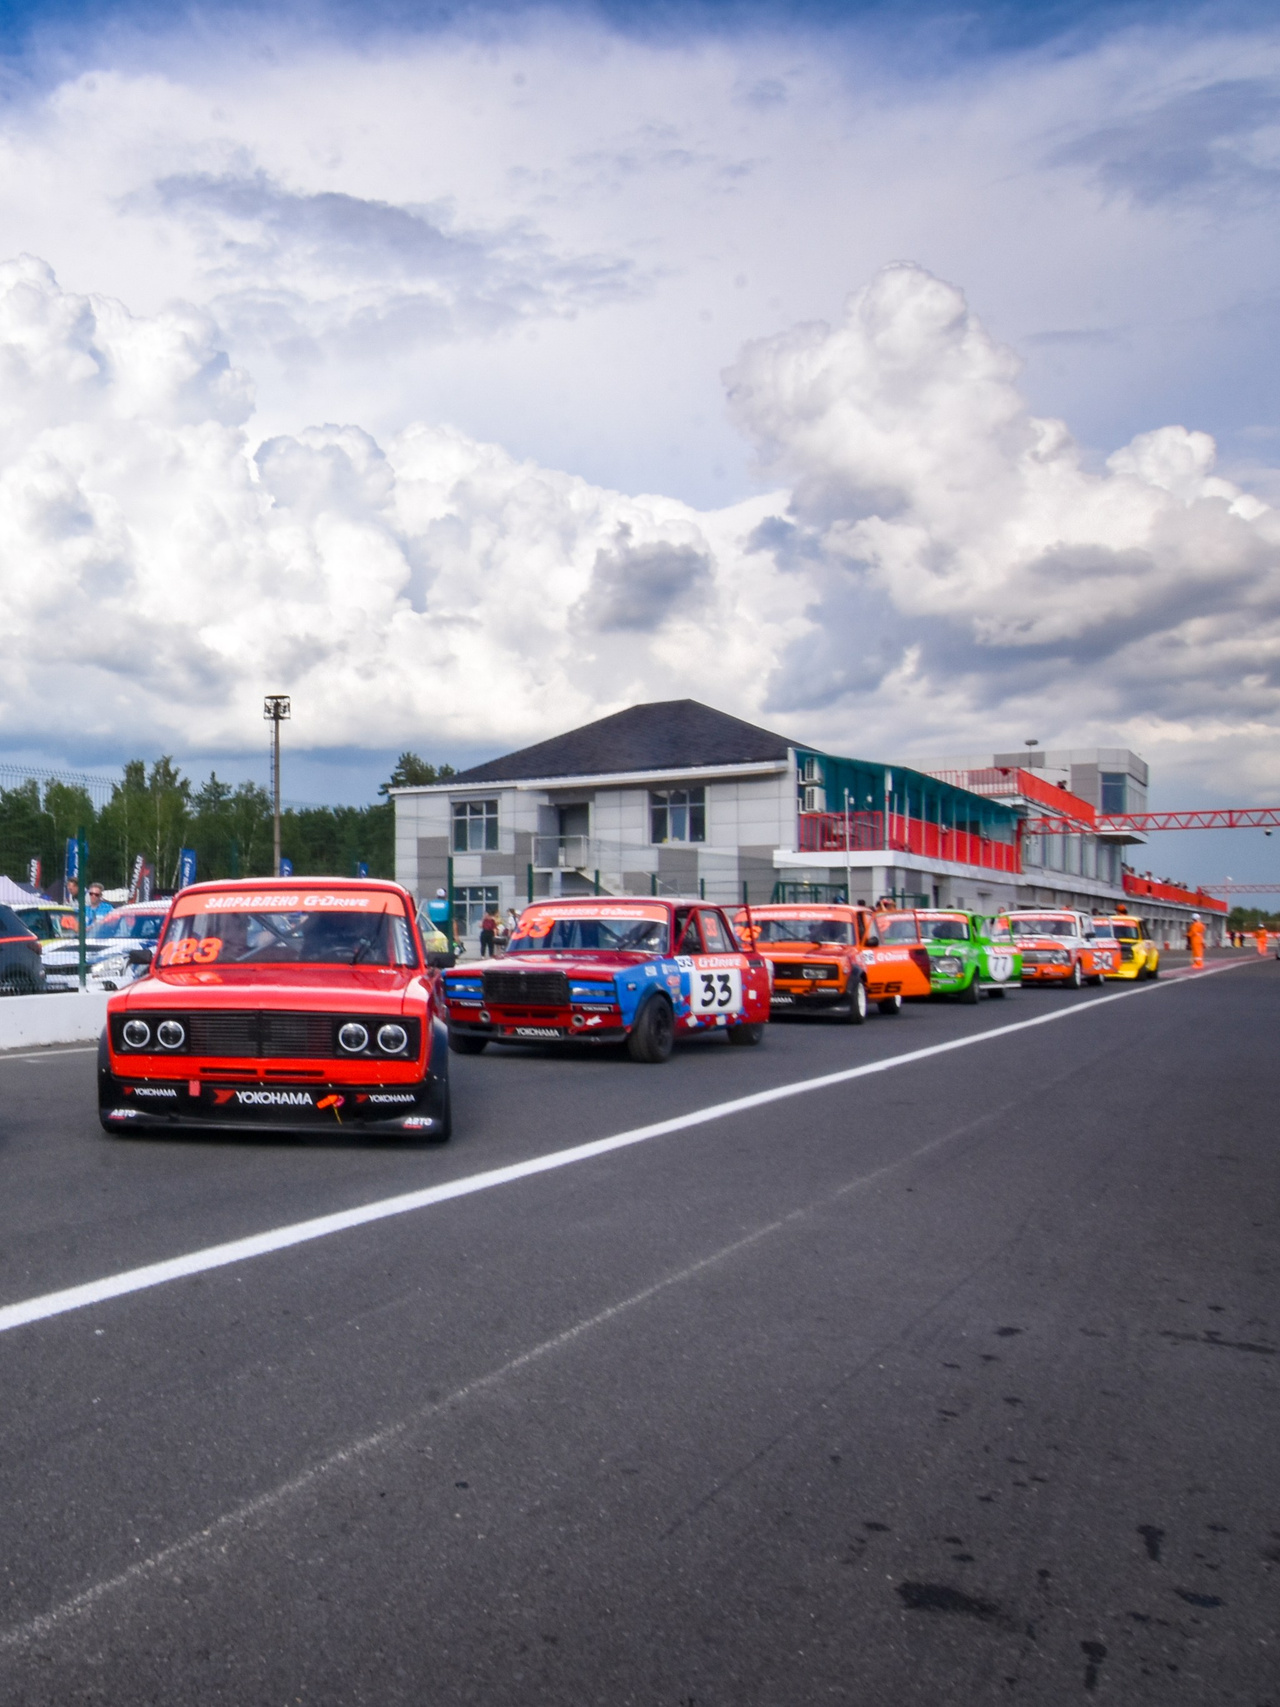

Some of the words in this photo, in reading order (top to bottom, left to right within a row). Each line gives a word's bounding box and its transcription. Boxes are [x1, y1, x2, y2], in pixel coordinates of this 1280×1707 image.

[205, 895, 298, 909] ЗАПРАВЛЕНО
[511, 917, 556, 940] 33
[160, 936, 223, 967] 123
[679, 958, 694, 968] 33
[992, 956, 1008, 972] 77
[700, 973, 732, 1008] 33
[515, 1027, 560, 1037] YOKOHAMA
[134, 1087, 177, 1097] YOKOHAMA
[235, 1090, 314, 1106] YOKOHAMA
[368, 1094, 416, 1103] YOKOHAMA
